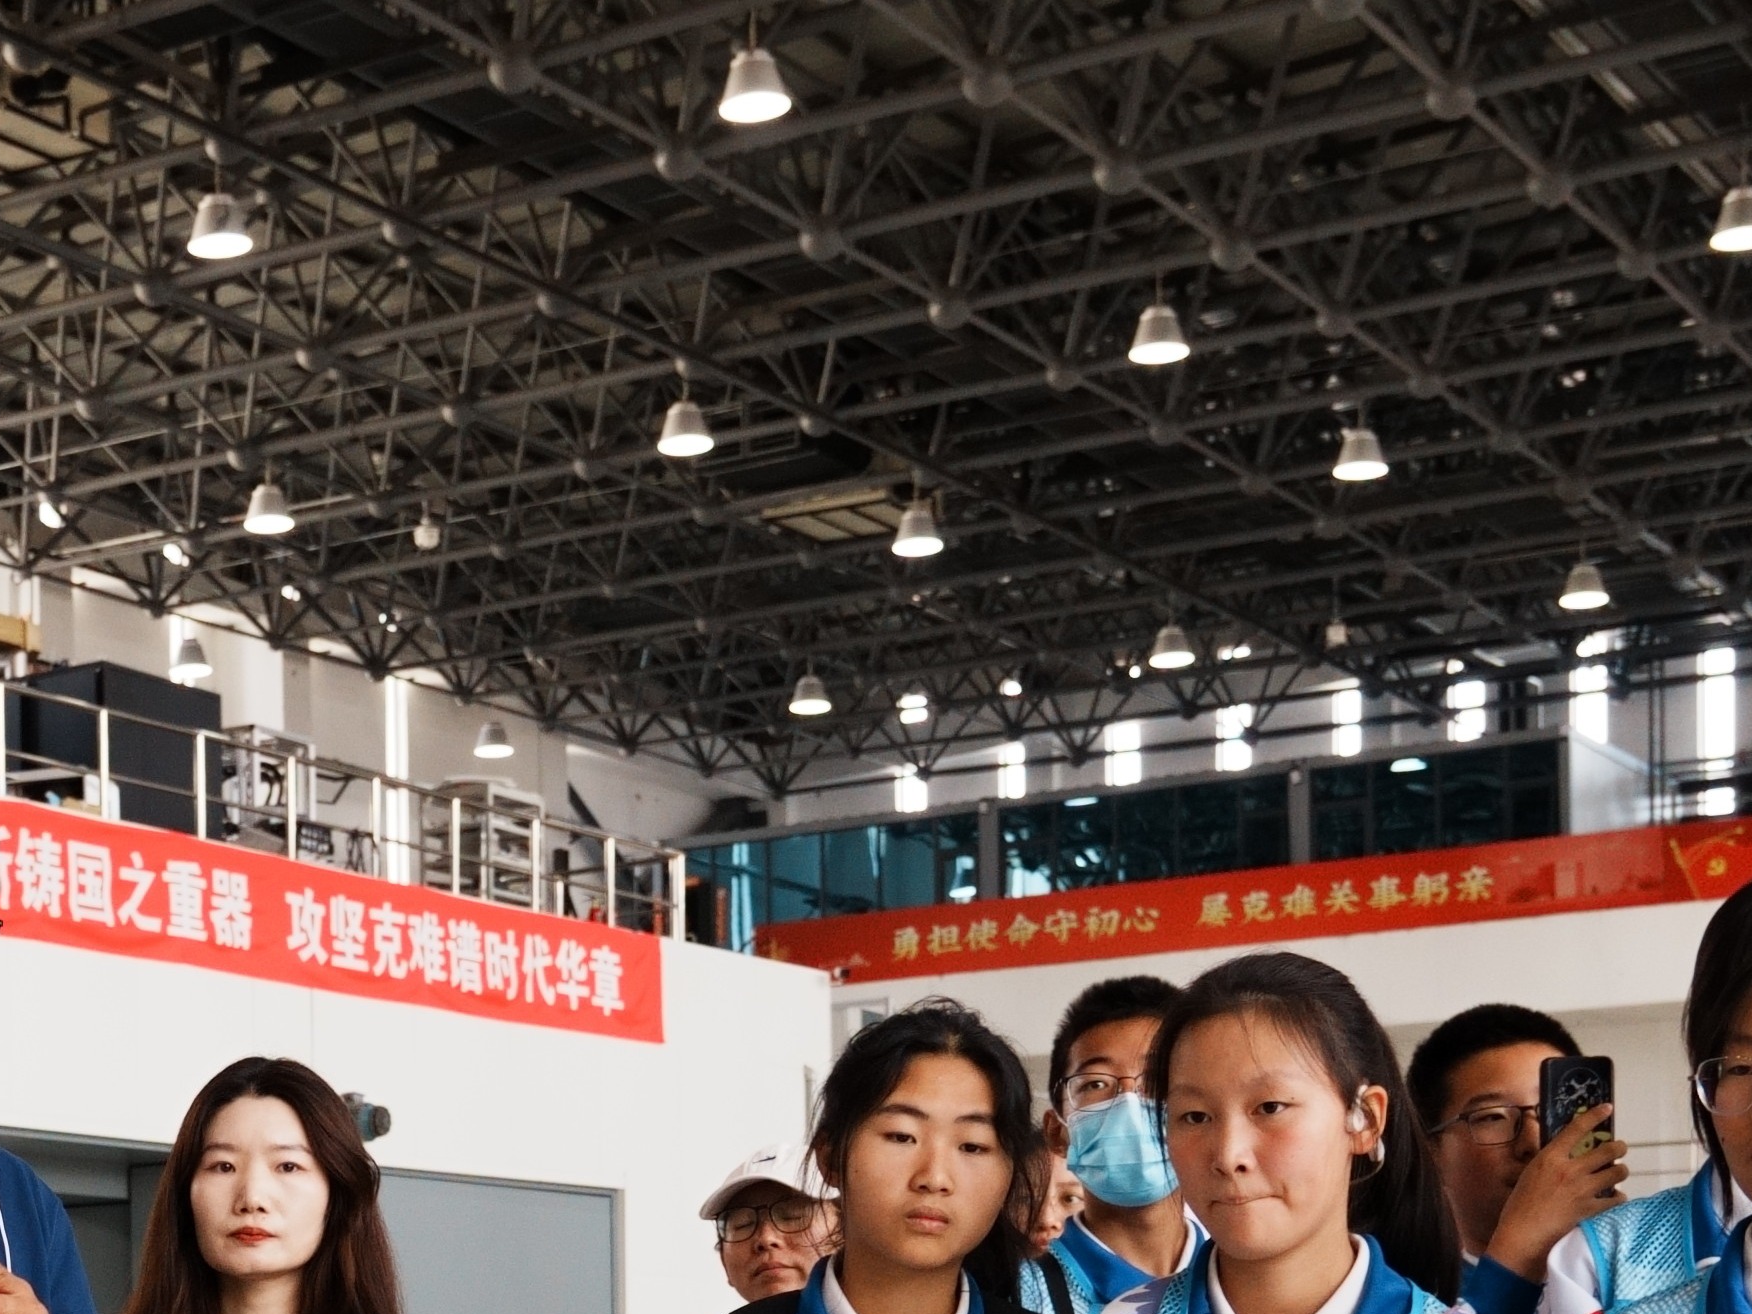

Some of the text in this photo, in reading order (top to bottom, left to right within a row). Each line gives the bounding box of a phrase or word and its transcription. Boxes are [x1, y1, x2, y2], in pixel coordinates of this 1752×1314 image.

[287, 887, 626, 1017] 攻坚克难谱时代华章
[892, 907, 1160, 960] 勇担使命守初心
